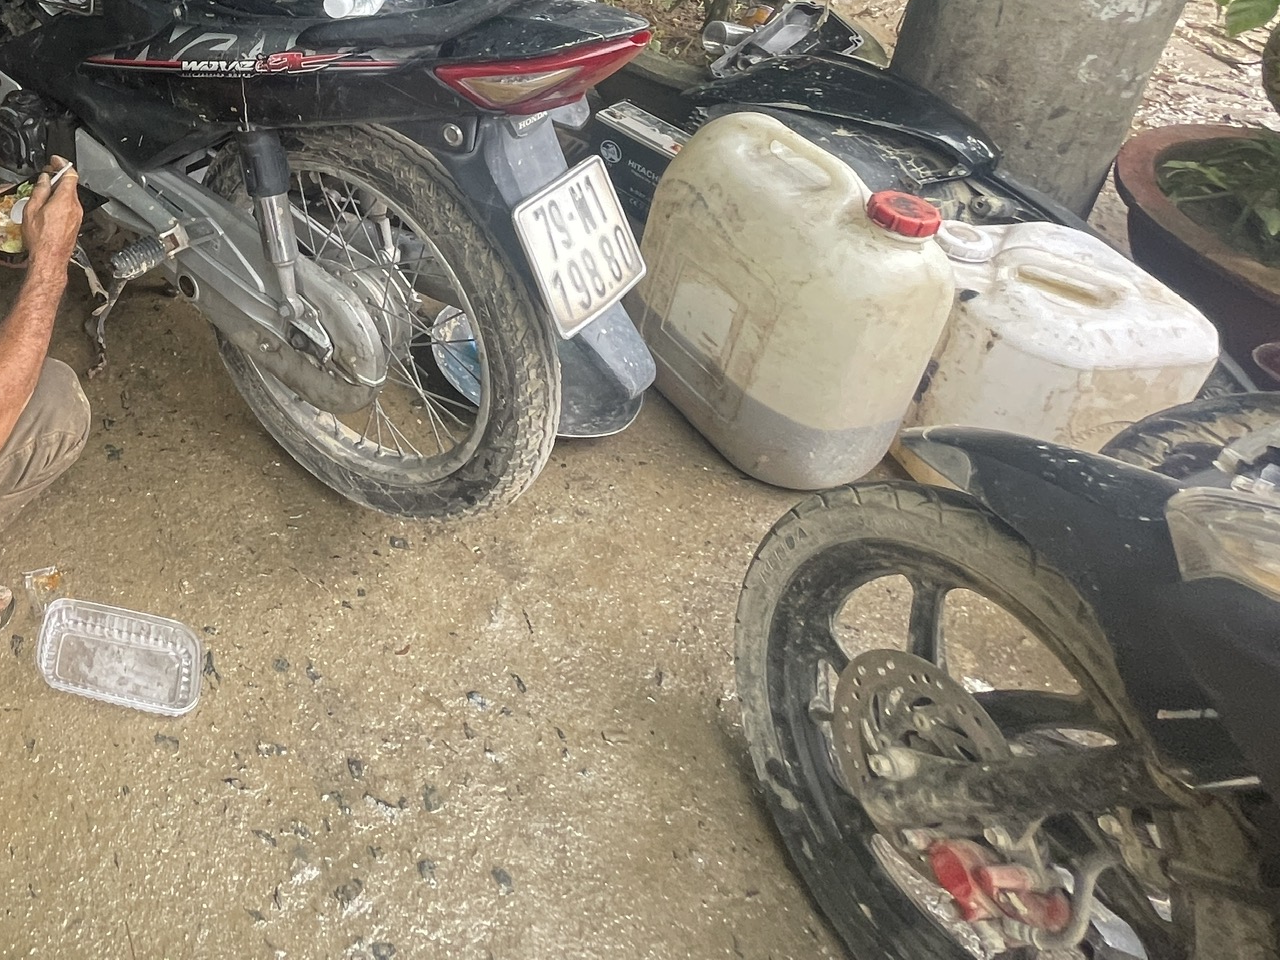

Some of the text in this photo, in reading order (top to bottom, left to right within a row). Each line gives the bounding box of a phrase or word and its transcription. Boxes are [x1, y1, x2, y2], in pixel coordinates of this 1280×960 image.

[518, 110, 549, 131] HONDA
[627, 158, 660, 182] HITACH
[552, 224, 634, 320] 198.80
